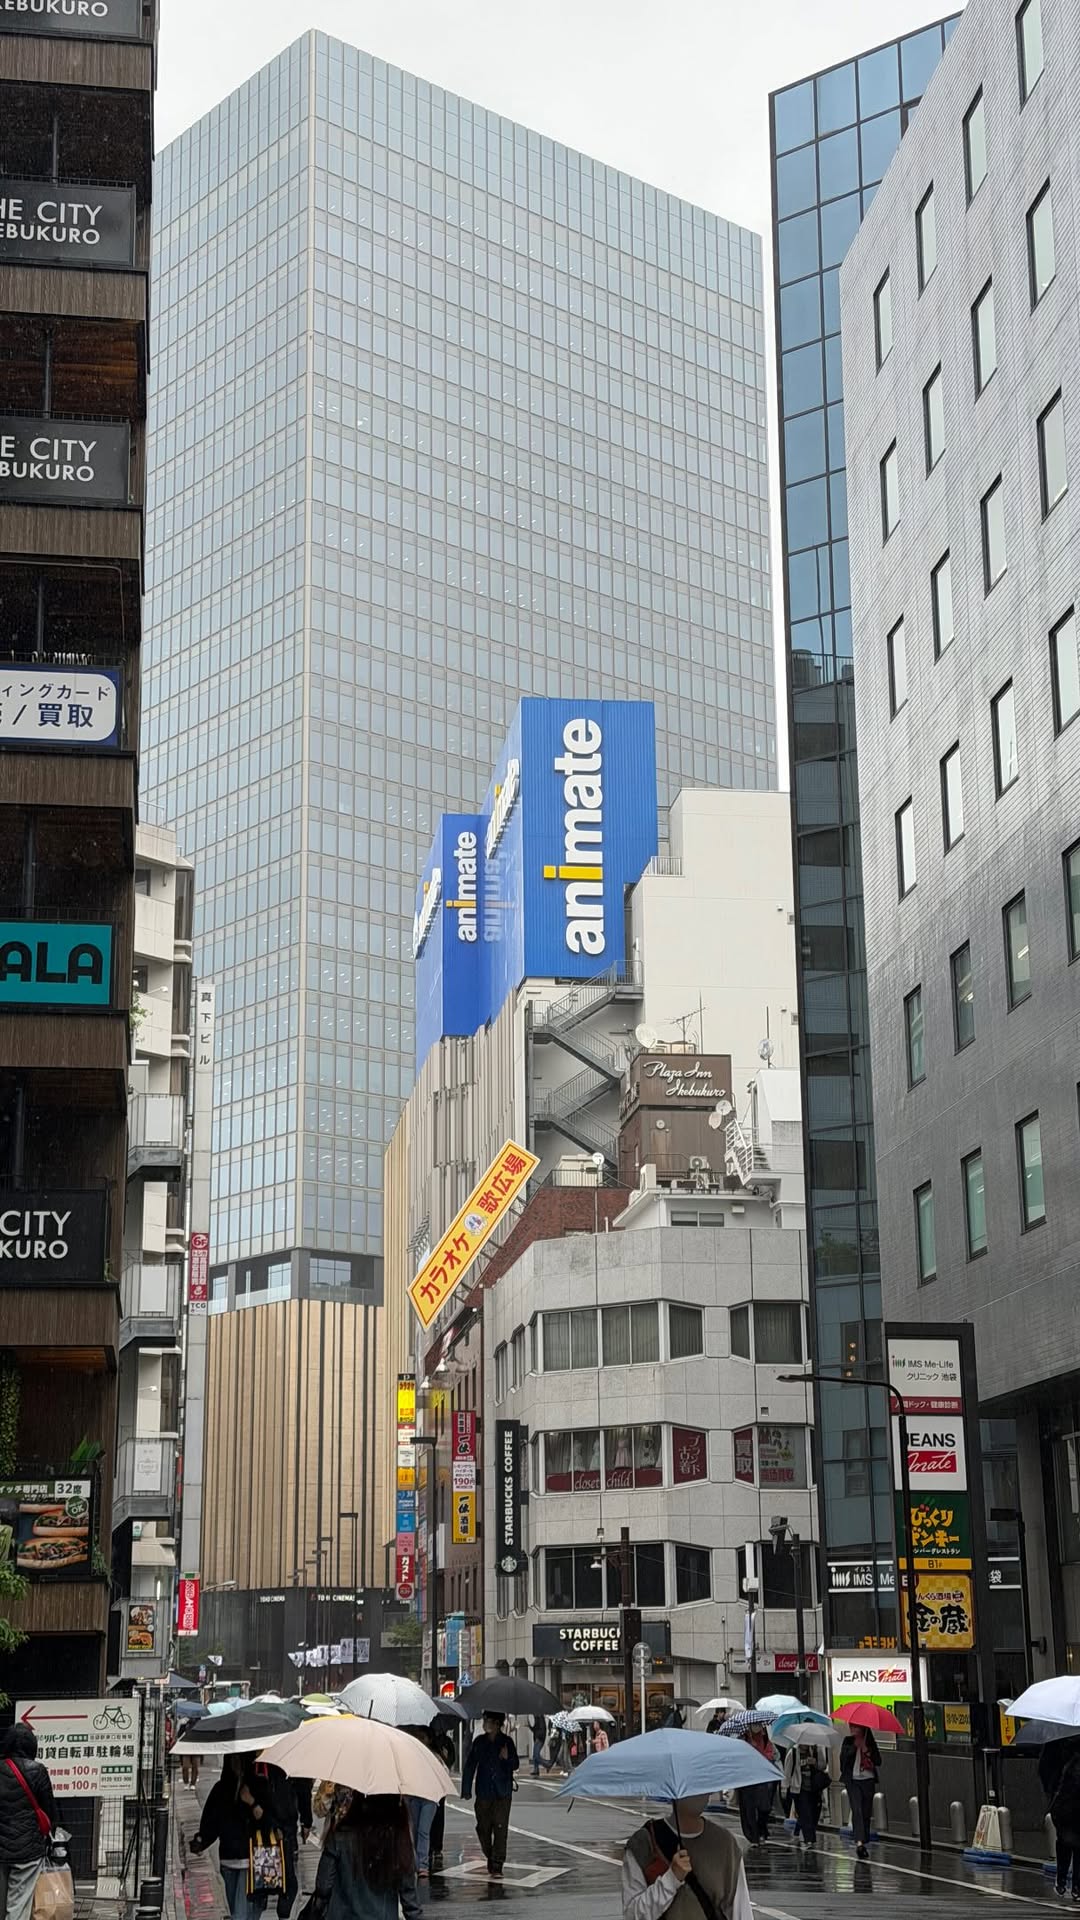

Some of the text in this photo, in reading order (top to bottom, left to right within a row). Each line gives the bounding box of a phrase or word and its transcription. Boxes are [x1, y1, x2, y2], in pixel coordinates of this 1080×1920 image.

[0, 0, 108, 17] EBUKURO
[37, 201, 102, 225] CITY
[30, 437, 97, 462] CITY
[0, 703, 93, 728] /買取
[543, 718, 605, 955] animate
[446, 831, 477, 942] animate
[199, 992, 211, 1065] 真下ビル
[643, 1061, 712, 1083] Plaza Inn
[666, 1079, 726, 1097] Ikebukuro
[0, 1210, 72, 1236] CITY
[420, 1152, 527, 1304] カラオケ 歌広場
[0, 1240, 69, 1259] KURO
[908, 1361, 922, 1369] IMS
[904, 1433, 956, 1447] EANS
[504, 1430, 513, 1546] COFFEE STARBUCKS
[574, 1472, 631, 1490] closet child
[853, 1573, 873, 1586] IMS
[918, 1592, 951, 1600] んくら酒場
[560, 1628, 620, 1640] STARBUC
[573, 1641, 619, 1651] COFFEE
[837, 1670, 877, 1682] JEANS
